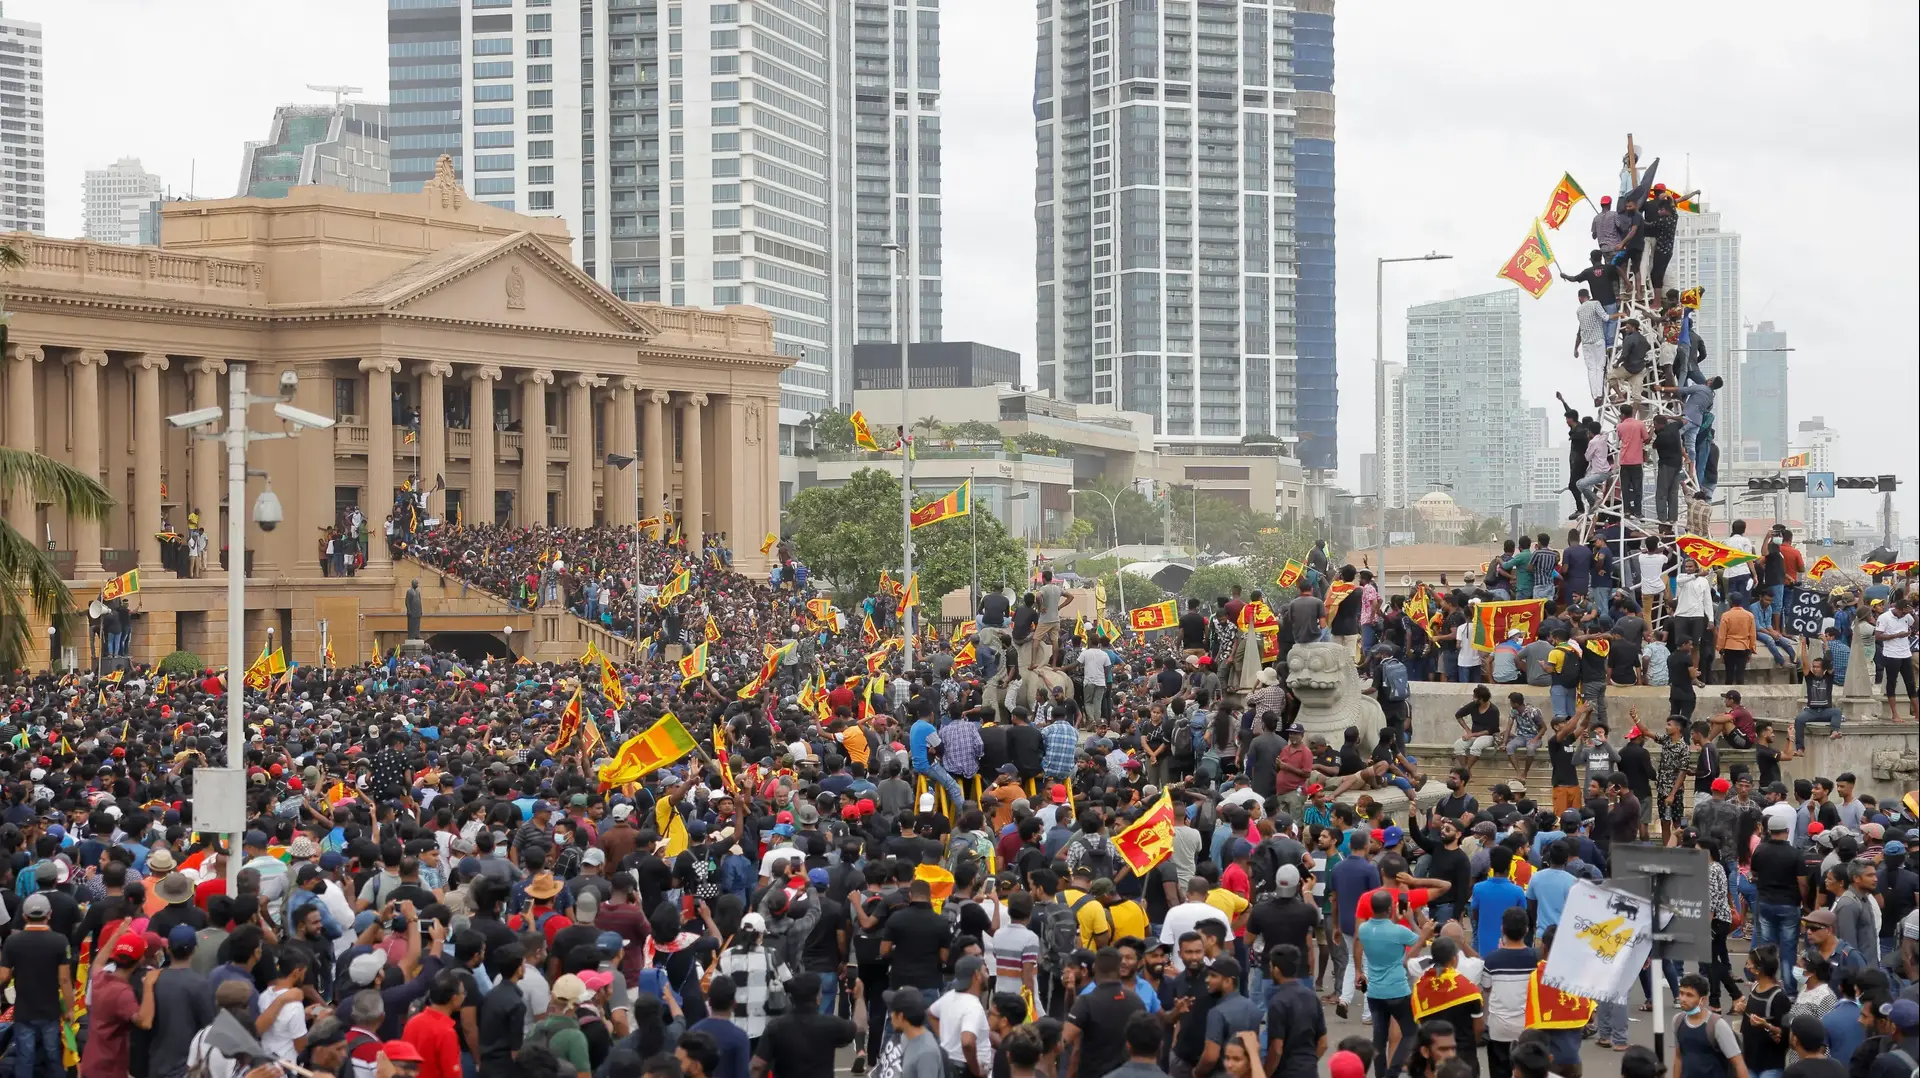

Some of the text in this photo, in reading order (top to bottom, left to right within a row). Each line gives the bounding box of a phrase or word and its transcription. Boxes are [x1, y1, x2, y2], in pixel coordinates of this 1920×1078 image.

[1799, 592, 1821, 604] GO
[1793, 605, 1823, 618] GOTA
[1793, 618, 1817, 633] GO
